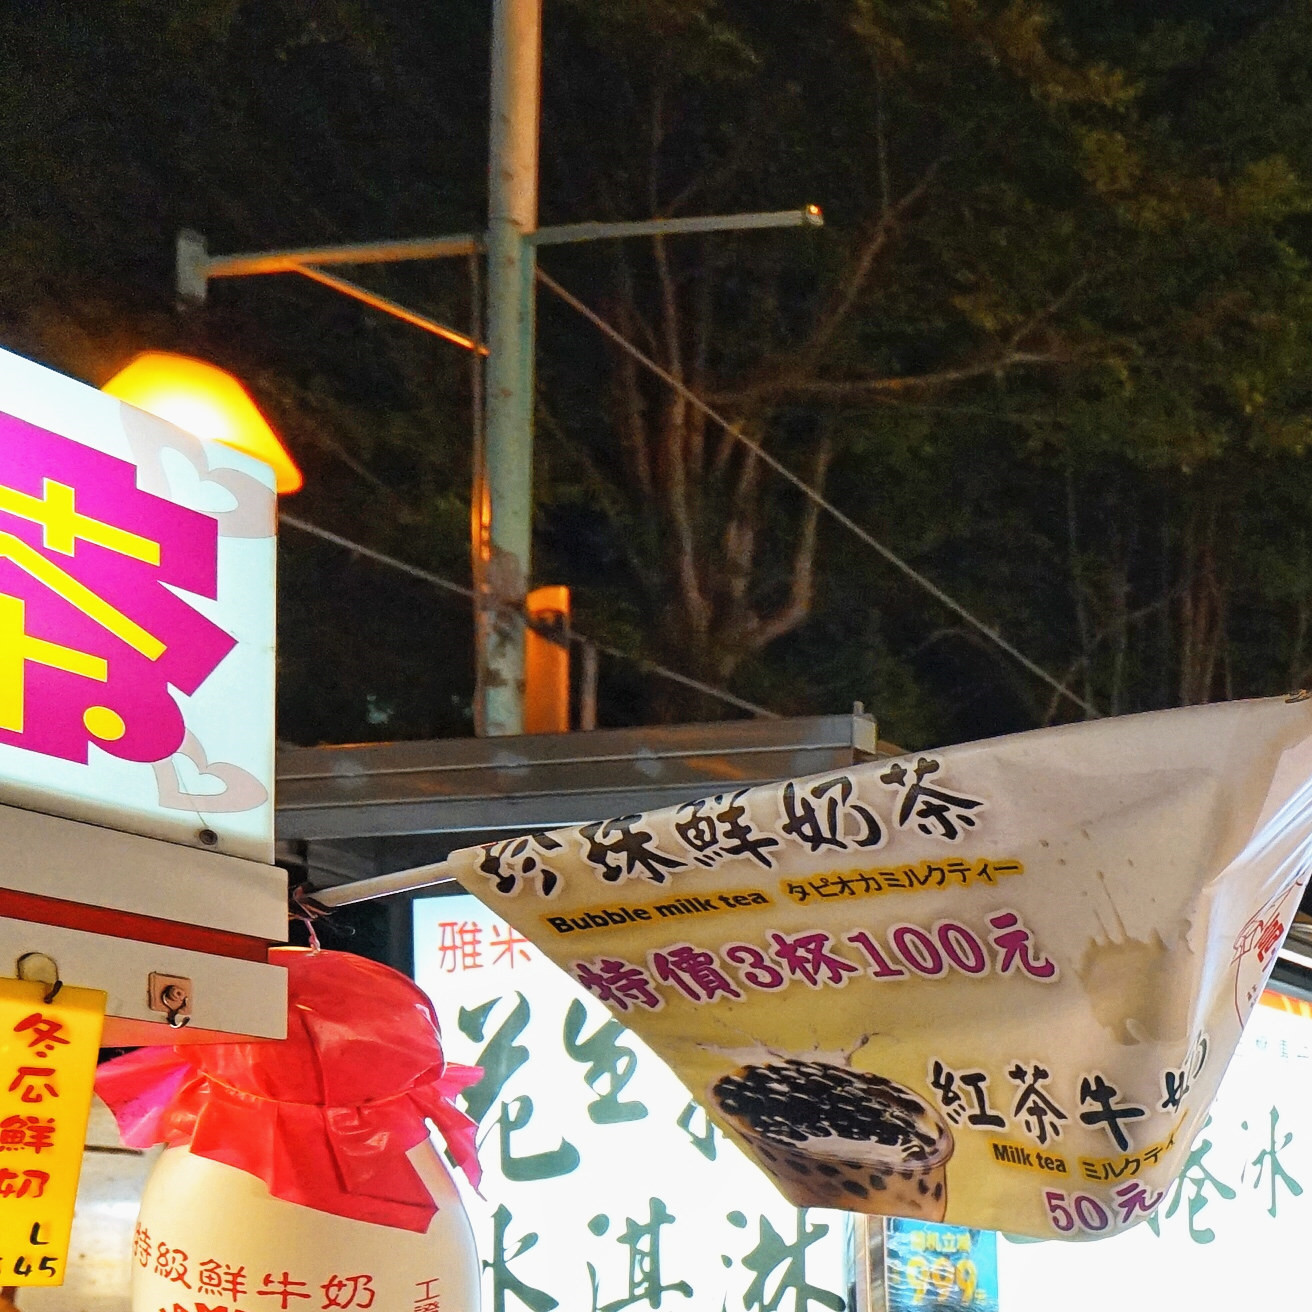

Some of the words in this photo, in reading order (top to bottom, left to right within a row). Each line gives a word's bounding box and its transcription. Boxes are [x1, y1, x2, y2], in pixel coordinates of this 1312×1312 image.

[481, 758, 984, 896] 珍珠鮮奶茶
[788, 862, 1022, 902] タピオカミルクティー
[550, 904, 654, 935] Bubble
[659, 892, 720, 922] milk
[723, 890, 769, 911] tea
[578, 912, 1056, 1011] 特價3杯100元
[0, 1012, 70, 1200] 冬瓜鮮奶
[444, 990, 728, 1181] 花生
[992, 1143, 1032, 1167] Milk
[1036, 1151, 1068, 1174] tea
[1083, 1137, 1182, 1180] ミルクティ
[1046, 1182, 1164, 1232] 50元
[0, 1255, 58, 1279] 45
[133, 1222, 376, 1312] 特級鮮牛奶
